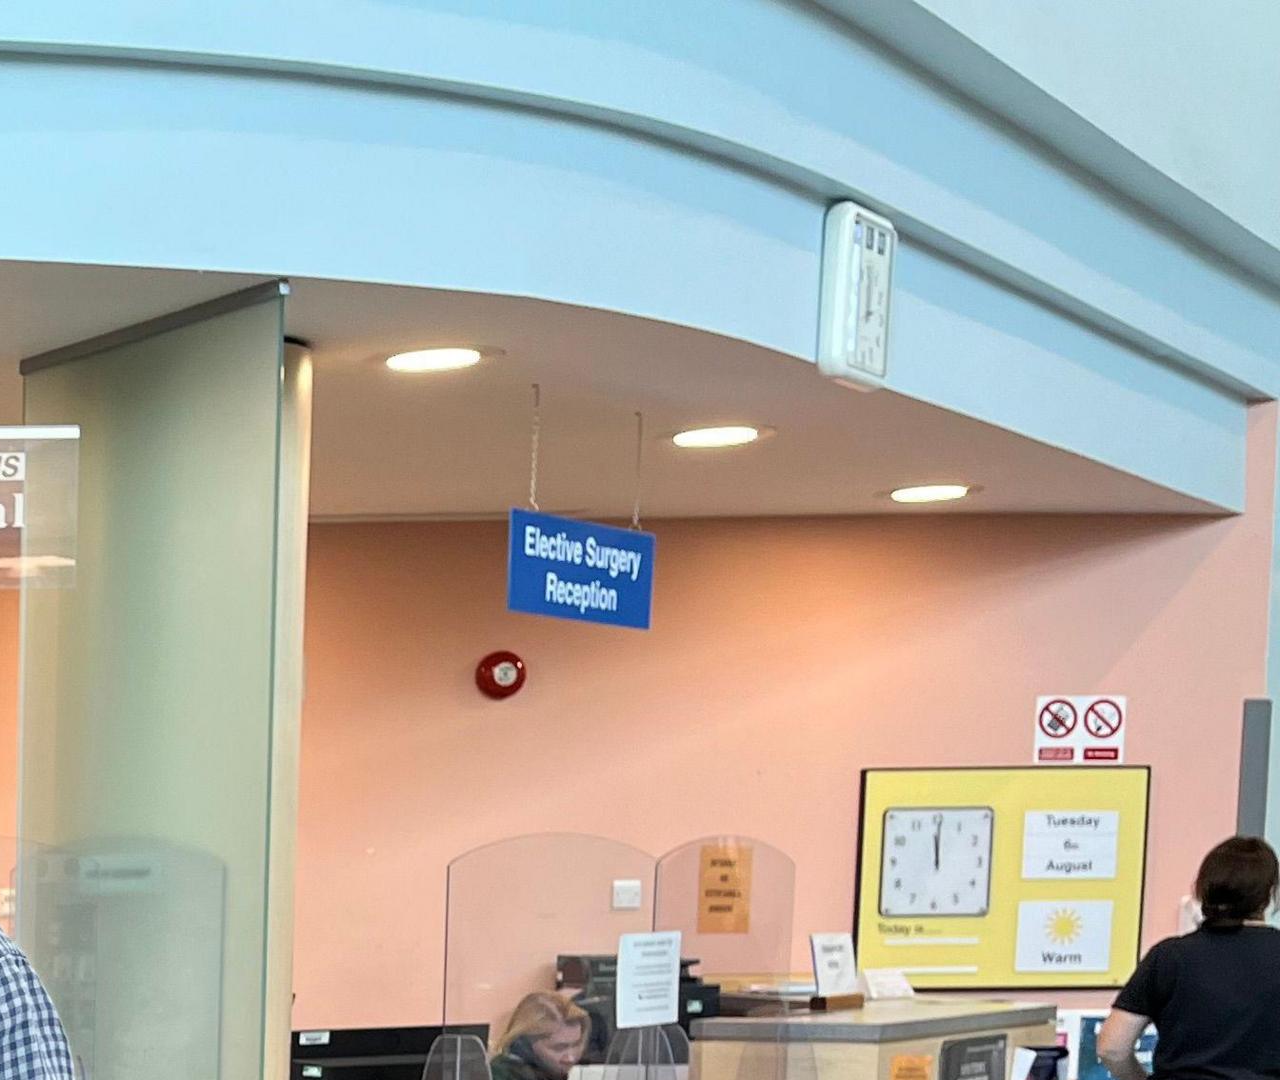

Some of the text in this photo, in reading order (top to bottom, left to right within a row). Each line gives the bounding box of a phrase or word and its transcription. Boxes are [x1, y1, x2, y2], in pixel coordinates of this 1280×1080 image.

[524, 525, 641, 581] Elective Surgery
[546, 571, 617, 614] Reception
[1046, 814, 1100, 829] Tuesday
[1046, 860, 1092, 875] August
[878, 924, 911, 935] Today
[1041, 952, 1082, 965] Warm
